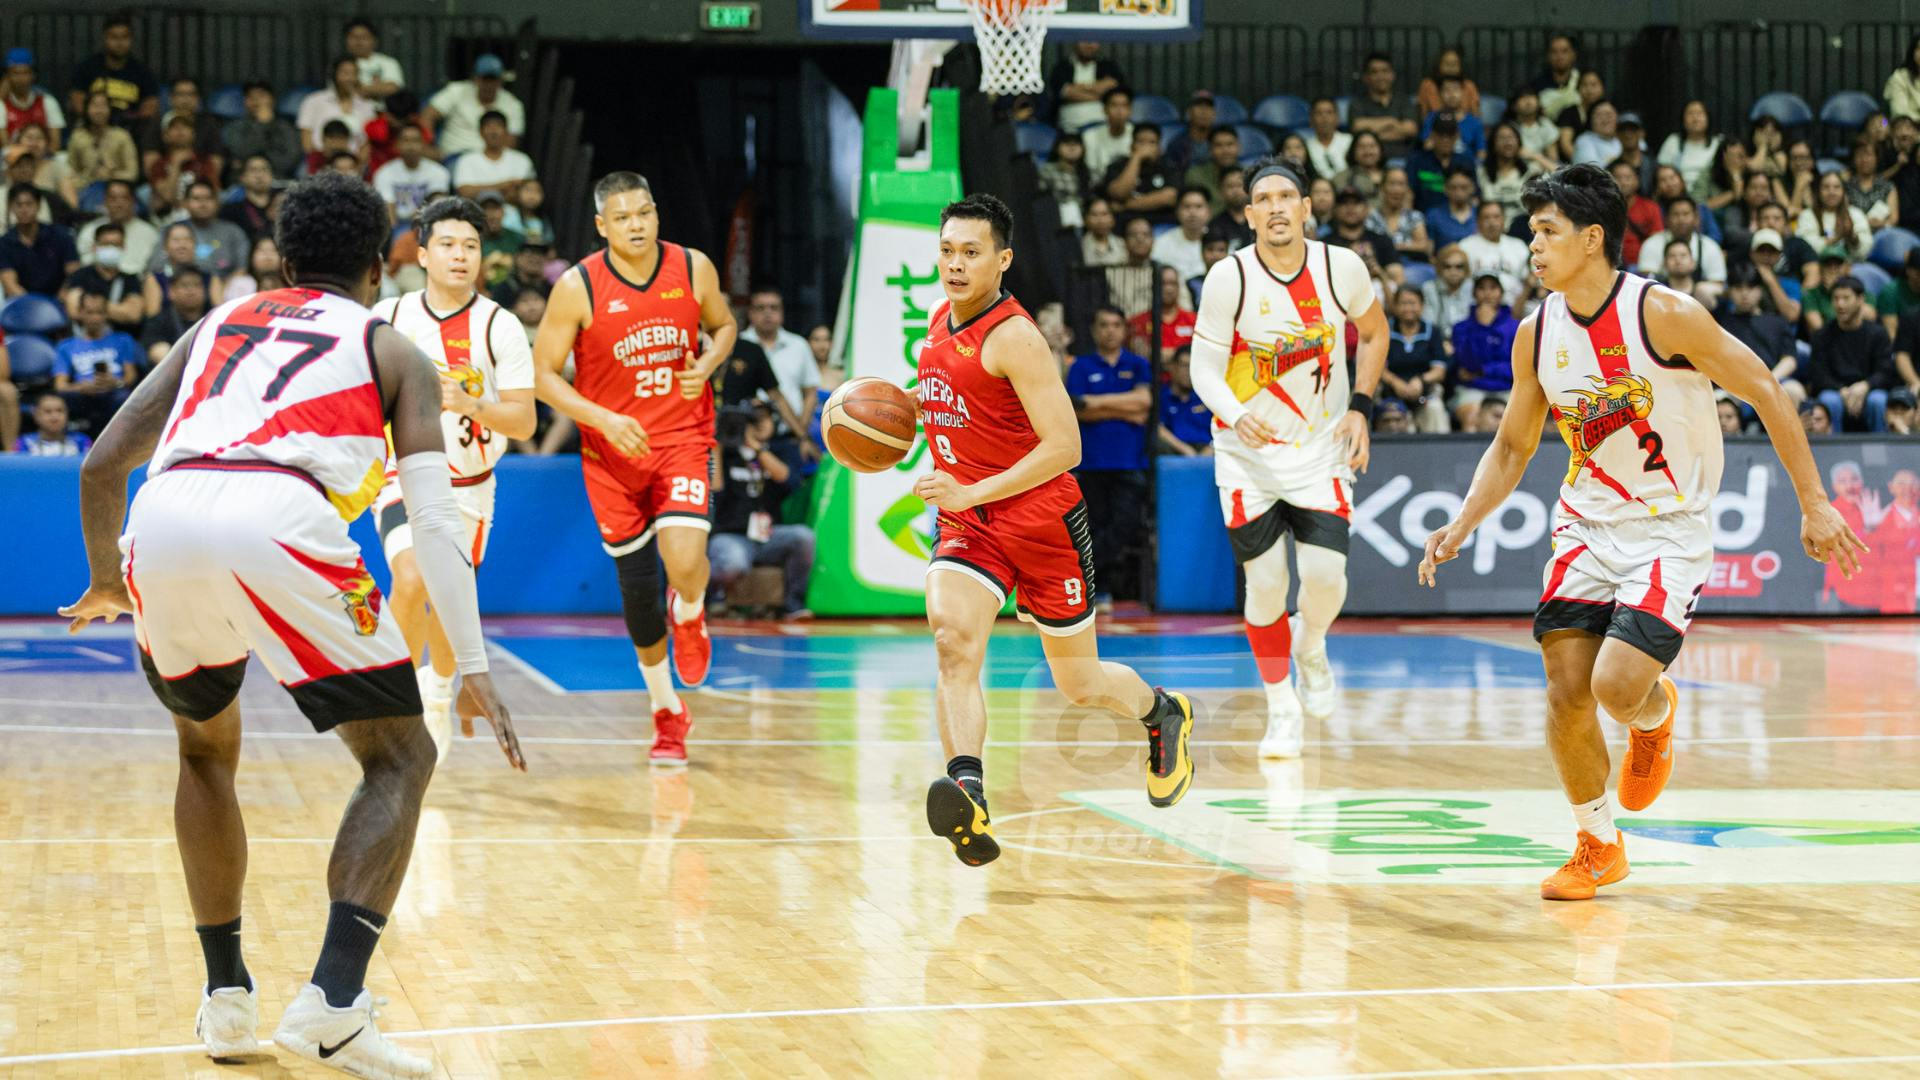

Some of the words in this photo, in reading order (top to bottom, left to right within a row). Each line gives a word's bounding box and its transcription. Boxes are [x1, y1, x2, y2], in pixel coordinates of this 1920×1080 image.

[709, 6, 752, 28] EXIT
[612, 326, 690, 361] GINEBRA
[206, 324, 340, 402] 77
[622, 354, 646, 368] SAN
[634, 367, 673, 398] 29
[1583, 404, 1637, 448] BEERMEN
[935, 434, 958, 464] 9
[1638, 431, 1668, 472] 2
[670, 476, 706, 506] 29
[1063, 577, 1082, 606] 9
